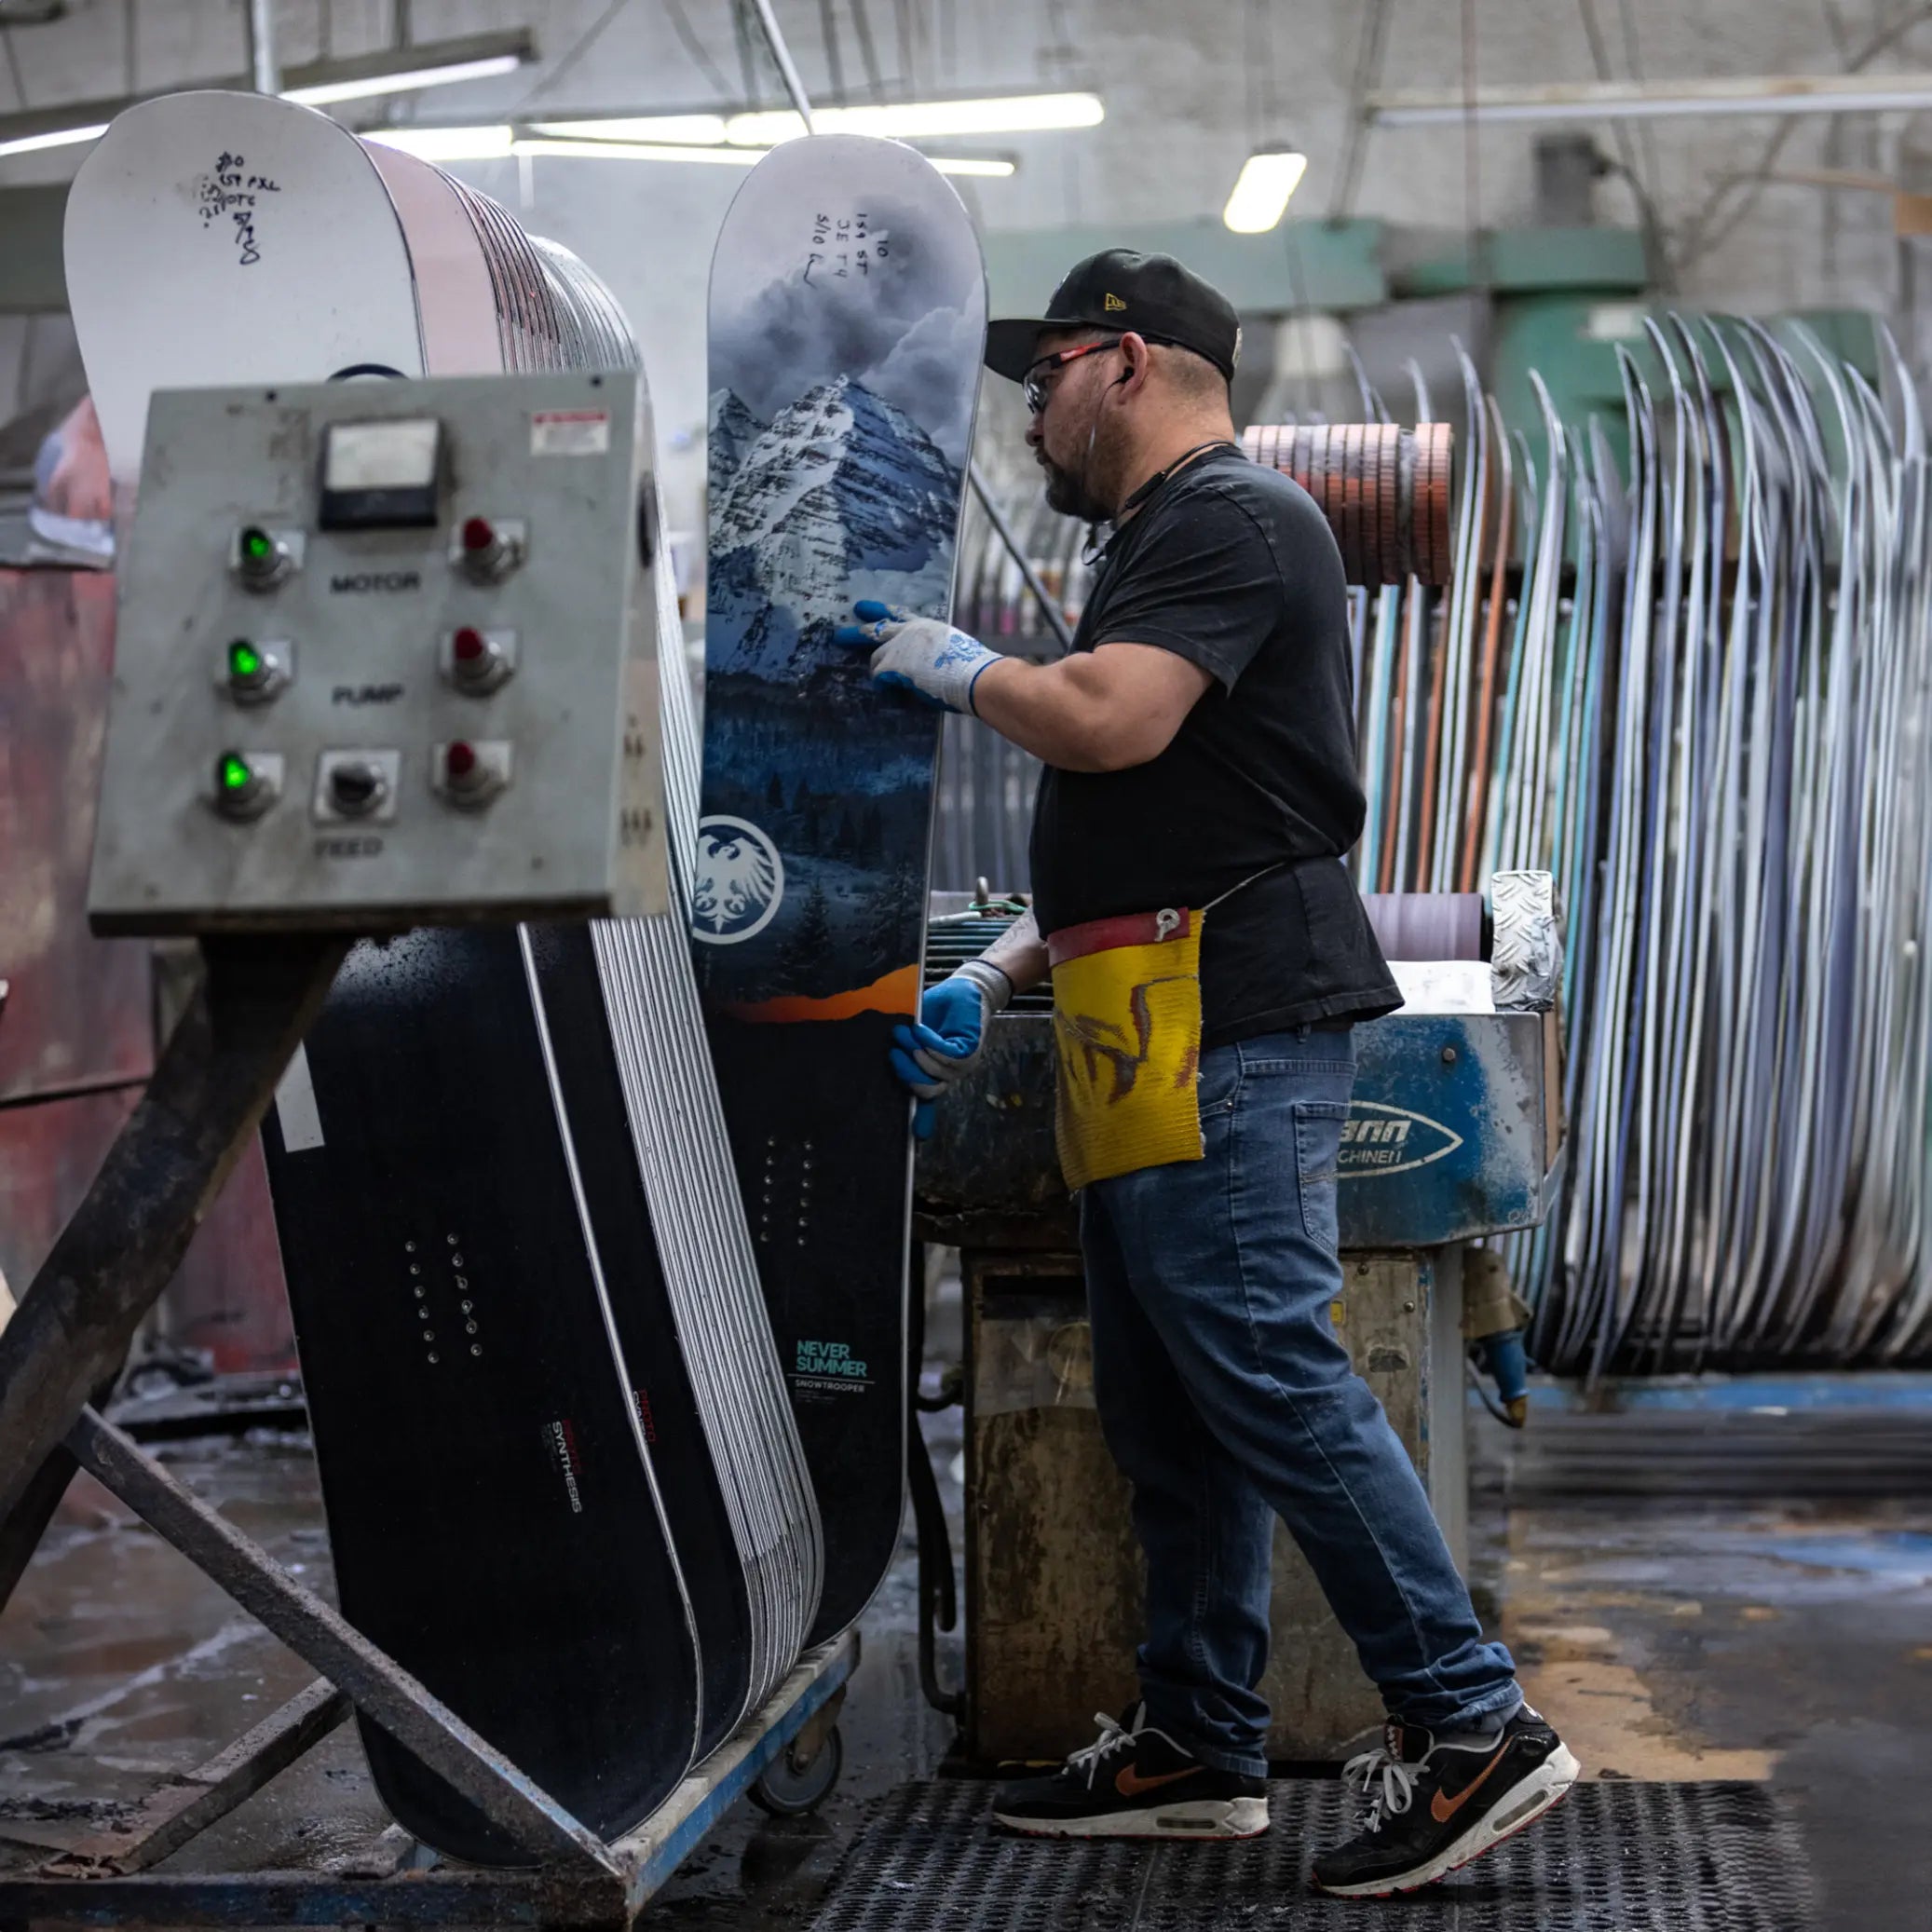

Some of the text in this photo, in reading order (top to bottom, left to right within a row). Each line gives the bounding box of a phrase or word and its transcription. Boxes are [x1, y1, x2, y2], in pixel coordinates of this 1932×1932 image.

[330, 573, 421, 595] MOTOR
[333, 685, 402, 707] PUMP
[314, 838, 384, 858] FEED
[796, 1340, 850, 1360] NEVER
[796, 1354, 868, 1378] SUMMER
[795, 1379, 865, 1394] SNOWTROOPER
[552, 1420, 583, 1515] SYNTHESIS
